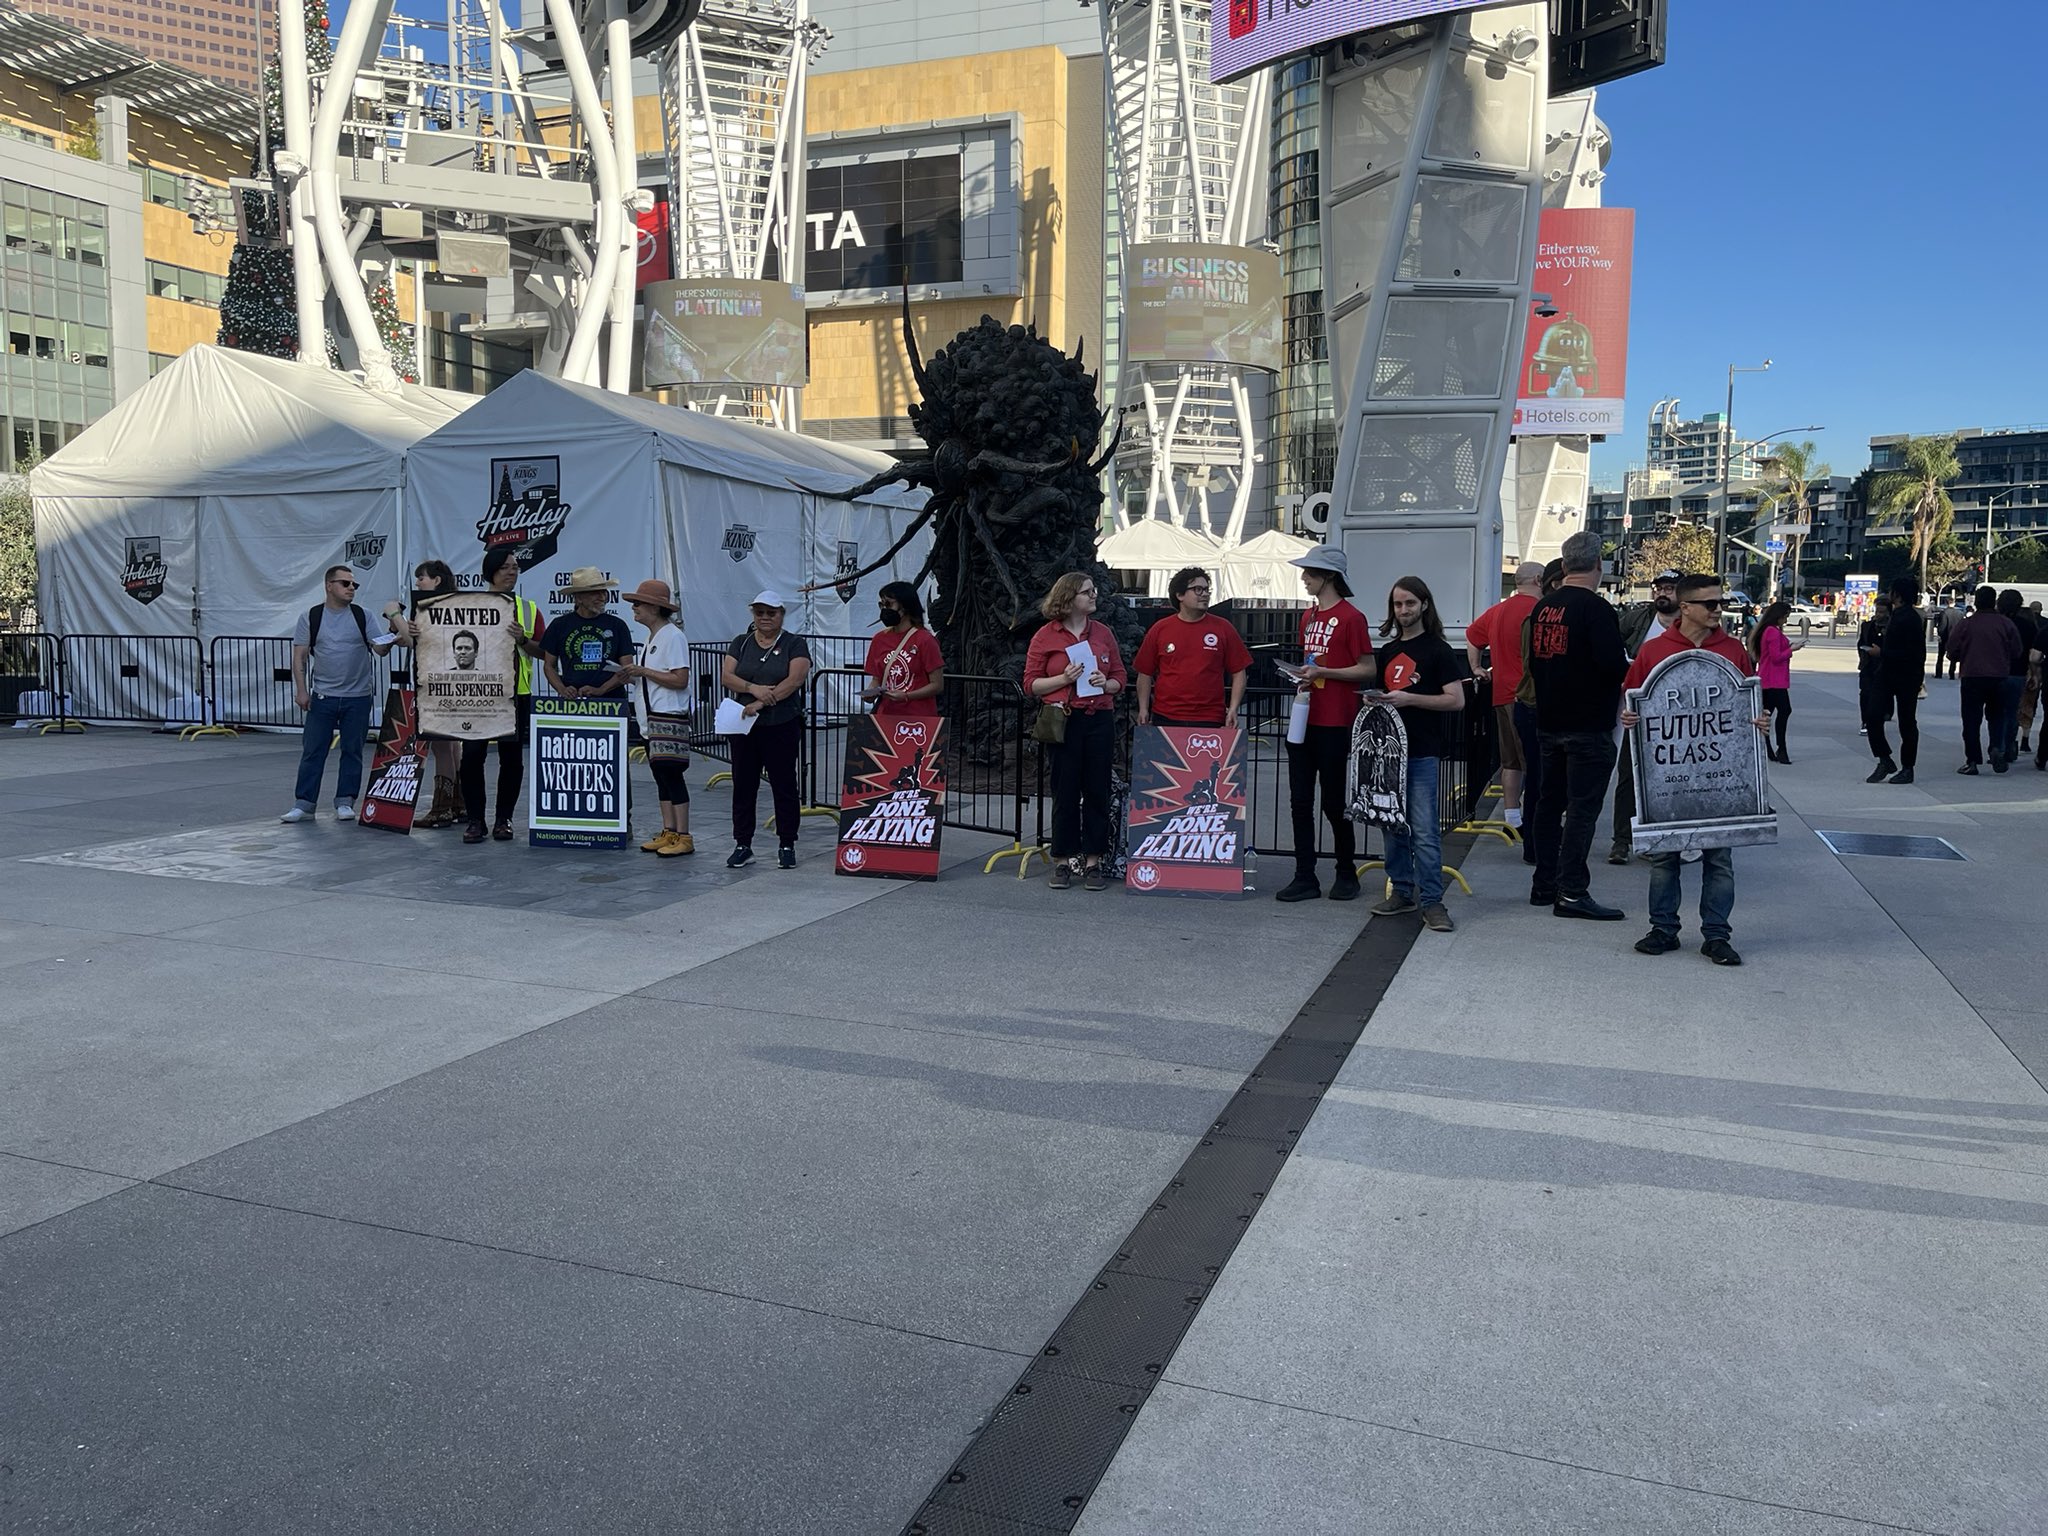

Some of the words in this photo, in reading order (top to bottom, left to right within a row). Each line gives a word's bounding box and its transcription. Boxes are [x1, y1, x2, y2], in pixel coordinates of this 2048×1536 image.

[1539, 243, 1574, 256] Either
[1575, 244, 1600, 256] way,
[1142, 257, 1249, 283] BUSINESS
[1554, 256, 1580, 269] YOUR
[1591, 259, 1614, 271] way
[675, 289, 705, 298] THERE'S
[706, 289, 743, 298] NOTHING
[674, 299, 762, 317] PLATINUM
[1526, 409, 1610, 423] Hotels.com
[513, 467, 538, 479] KINGS
[479, 499, 568, 539] Holiday
[506, 533, 520, 541] LIVE
[527, 526, 547, 540] ICE
[724, 531, 755, 550] KINGS
[348, 538, 387, 559] KINGS
[121, 560, 167, 584] Holiday
[429, 608, 500, 626] WANTED
[1538, 606, 1566, 623] CWA
[1394, 665, 1404, 679] 7
[428, 683, 453, 696] PHIL
[455, 684, 504, 697] SPENCER
[535, 700, 622, 715] SOLIDARITY
[1646, 710, 1734, 742] FUTURE
[541, 733, 614, 761] national
[1654, 742, 1722, 765] CLASS
[384, 763, 419, 778] DONE
[541, 761, 614, 793] WRITERS
[1664, 775, 1690, 783] 2020
[1705, 769, 1733, 779] 2023
[367, 779, 419, 802] PLAYING
[891, 789, 920, 800] WE'RE
[541, 791, 614, 812] union
[869, 800, 930, 818] DONE
[1186, 804, 1218, 815] WE'RE
[842, 818, 936, 844] PLAYING
[1161, 815, 1229, 834] DONE
[536, 832, 567, 841] National
[568, 834, 597, 842] Writers
[597, 834, 620, 843] Union
[1132, 834, 1237, 860] PLAYING
